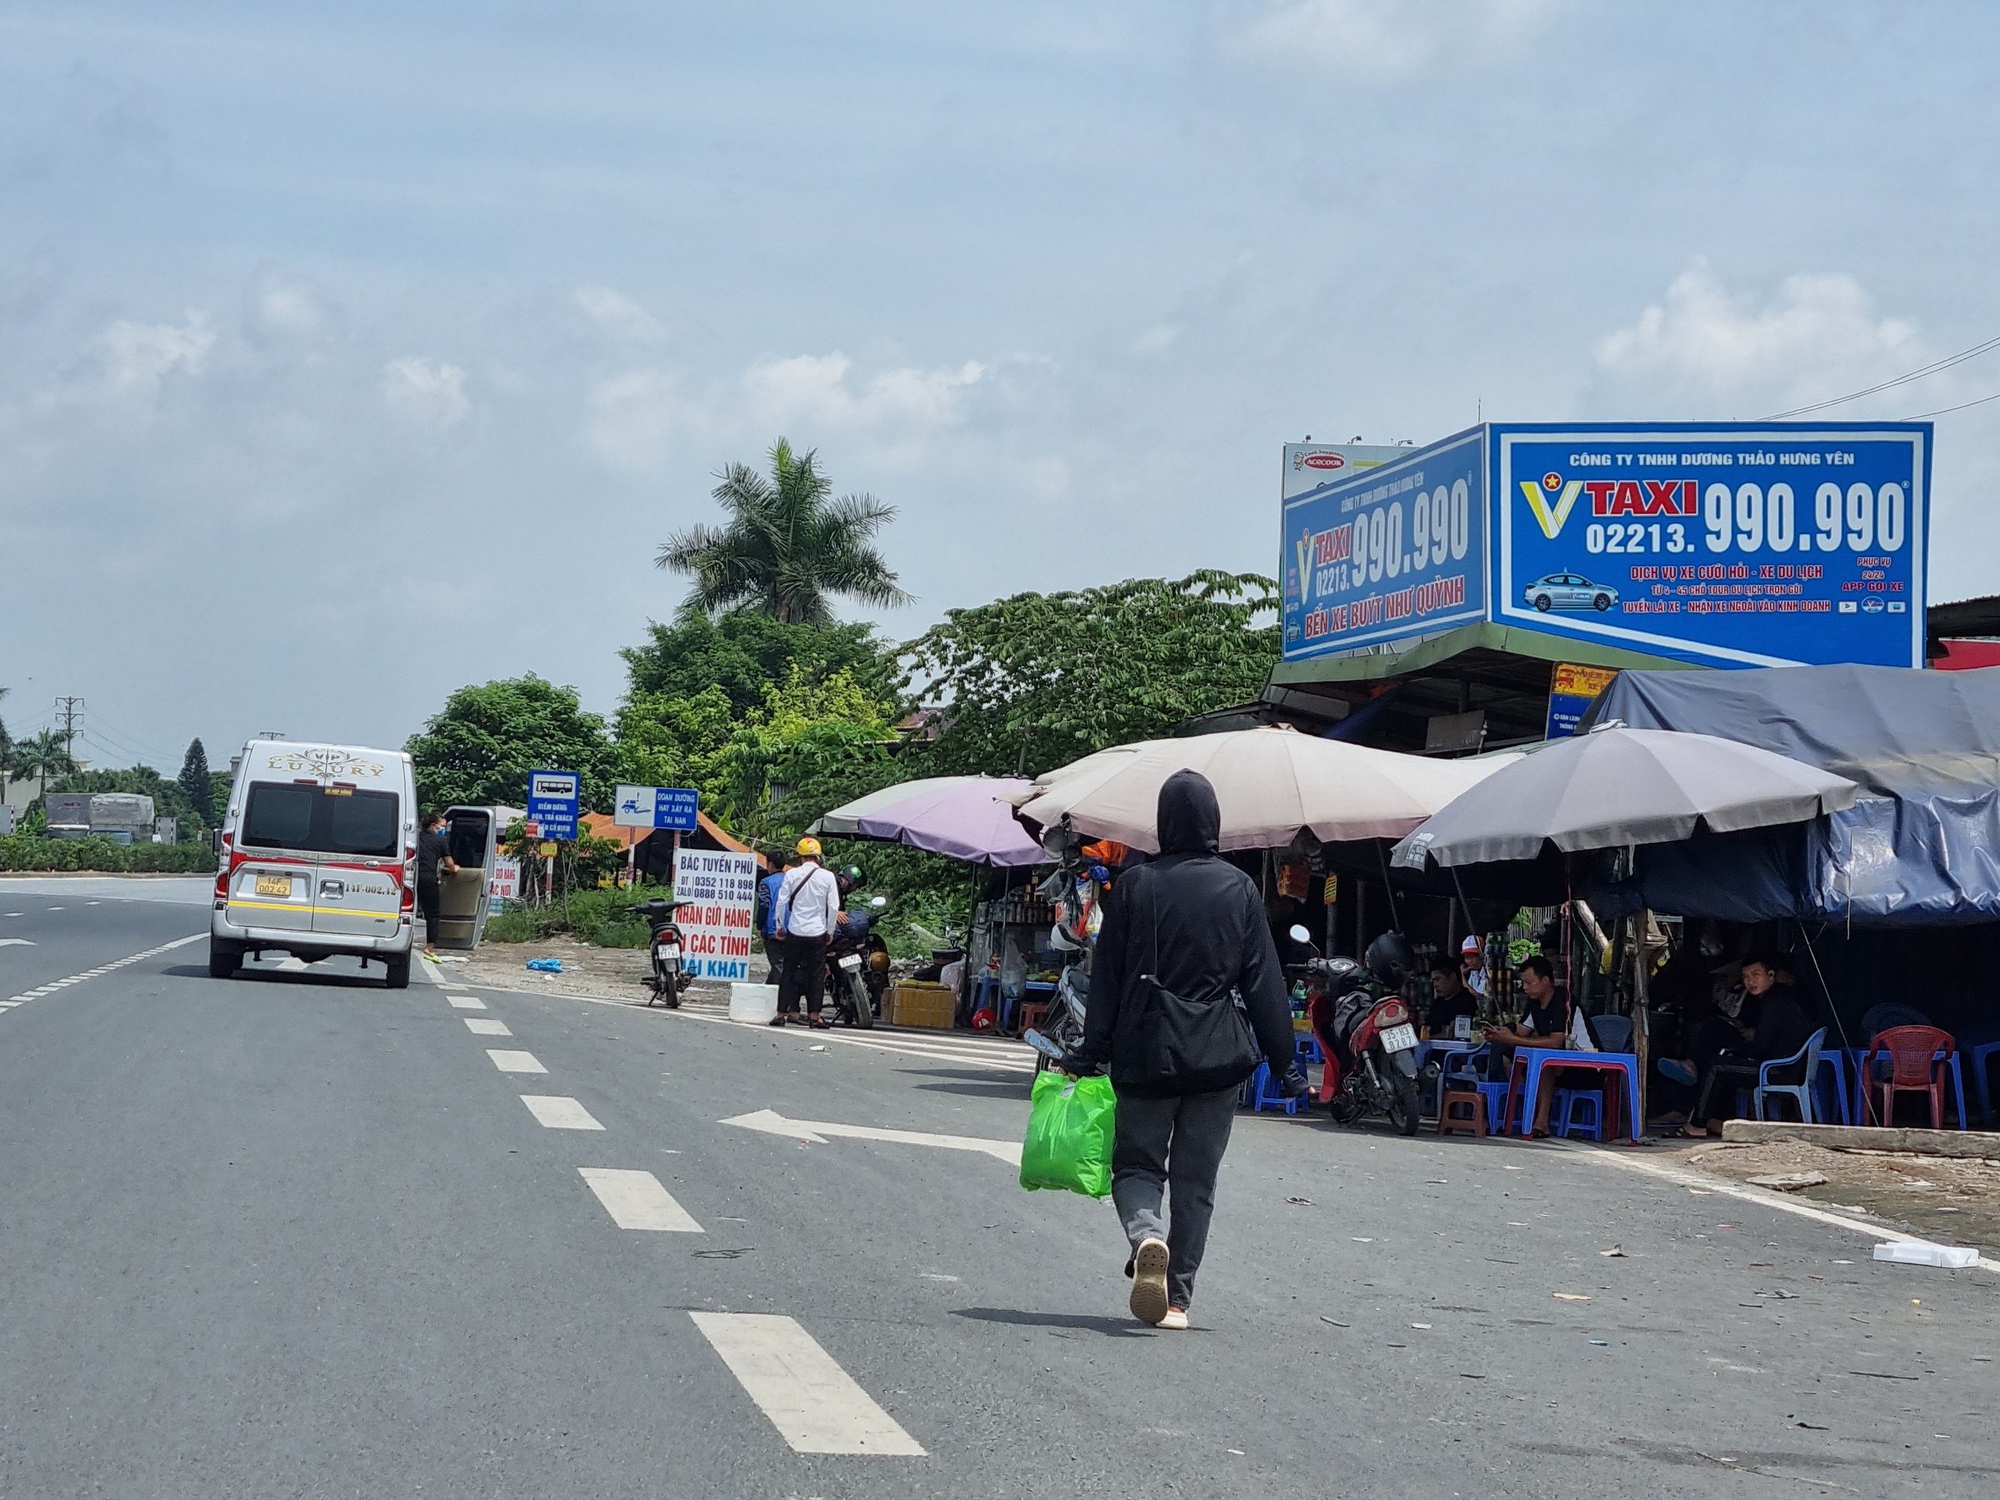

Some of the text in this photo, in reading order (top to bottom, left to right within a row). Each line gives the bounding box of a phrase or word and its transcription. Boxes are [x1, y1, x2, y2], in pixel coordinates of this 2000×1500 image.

[1569, 449, 1855, 466] CÔNG TY TNHH DƯƠNG THẢO HƯNG YÊN
[1584, 480, 1698, 517] TAXI
[1586, 482, 1905, 553] 02213. 990.990
[1315, 523, 1351, 567] TAXI
[1316, 478, 1469, 598] 02213. 990.990
[1630, 565, 1660, 583] DỊCH
[1661, 565, 1678, 583] VỤ
[1680, 565, 1696, 580] XE
[1697, 562, 1726, 580] CƯỚI
[1728, 561, 1749, 580] HỎI
[1759, 564, 1776, 580] XE
[1777, 564, 1794, 580] DU
[1796, 564, 1824, 582] LỊCH
[1861, 570, 1886, 580] 24/24
[1676, 585, 1688, 596] 45
[1708, 585, 1729, 596] TOUR
[1730, 585, 1743, 595] DU
[1744, 585, 1763, 597] LỊCH
[1842, 581, 1905, 593] APP GỌI XE
[1305, 603, 1329, 640] BẾN
[1331, 604, 1348, 633] XE
[1384, 584, 1415, 620] NHƯ
[1416, 574, 1465, 616] QUỲNH
[1668, 601, 1681, 613] XE
[1688, 599, 1713, 615] NHẬN
[1715, 601, 1727, 613] XE
[1776, 600, 1800, 613] KINH
[1800, 600, 1832, 613] DOANH
[268, 761, 385, 777] LUXURY
[658, 804, 670, 812] HAY
[684, 805, 693, 814] RA
[680, 853, 754, 875] BÁC TUYẾN PHÚ
[676, 886, 753, 902] ZALO 0888 510 444
[694, 876, 717, 888] 0352
[719, 877, 736, 889] 118
[737, 879, 754, 890] 898
[723, 904, 751, 929] HÀNG
[690, 930, 717, 954] CÁC
[720, 929, 750, 957] TỈNH
[706, 957, 748, 979] KHÁT
